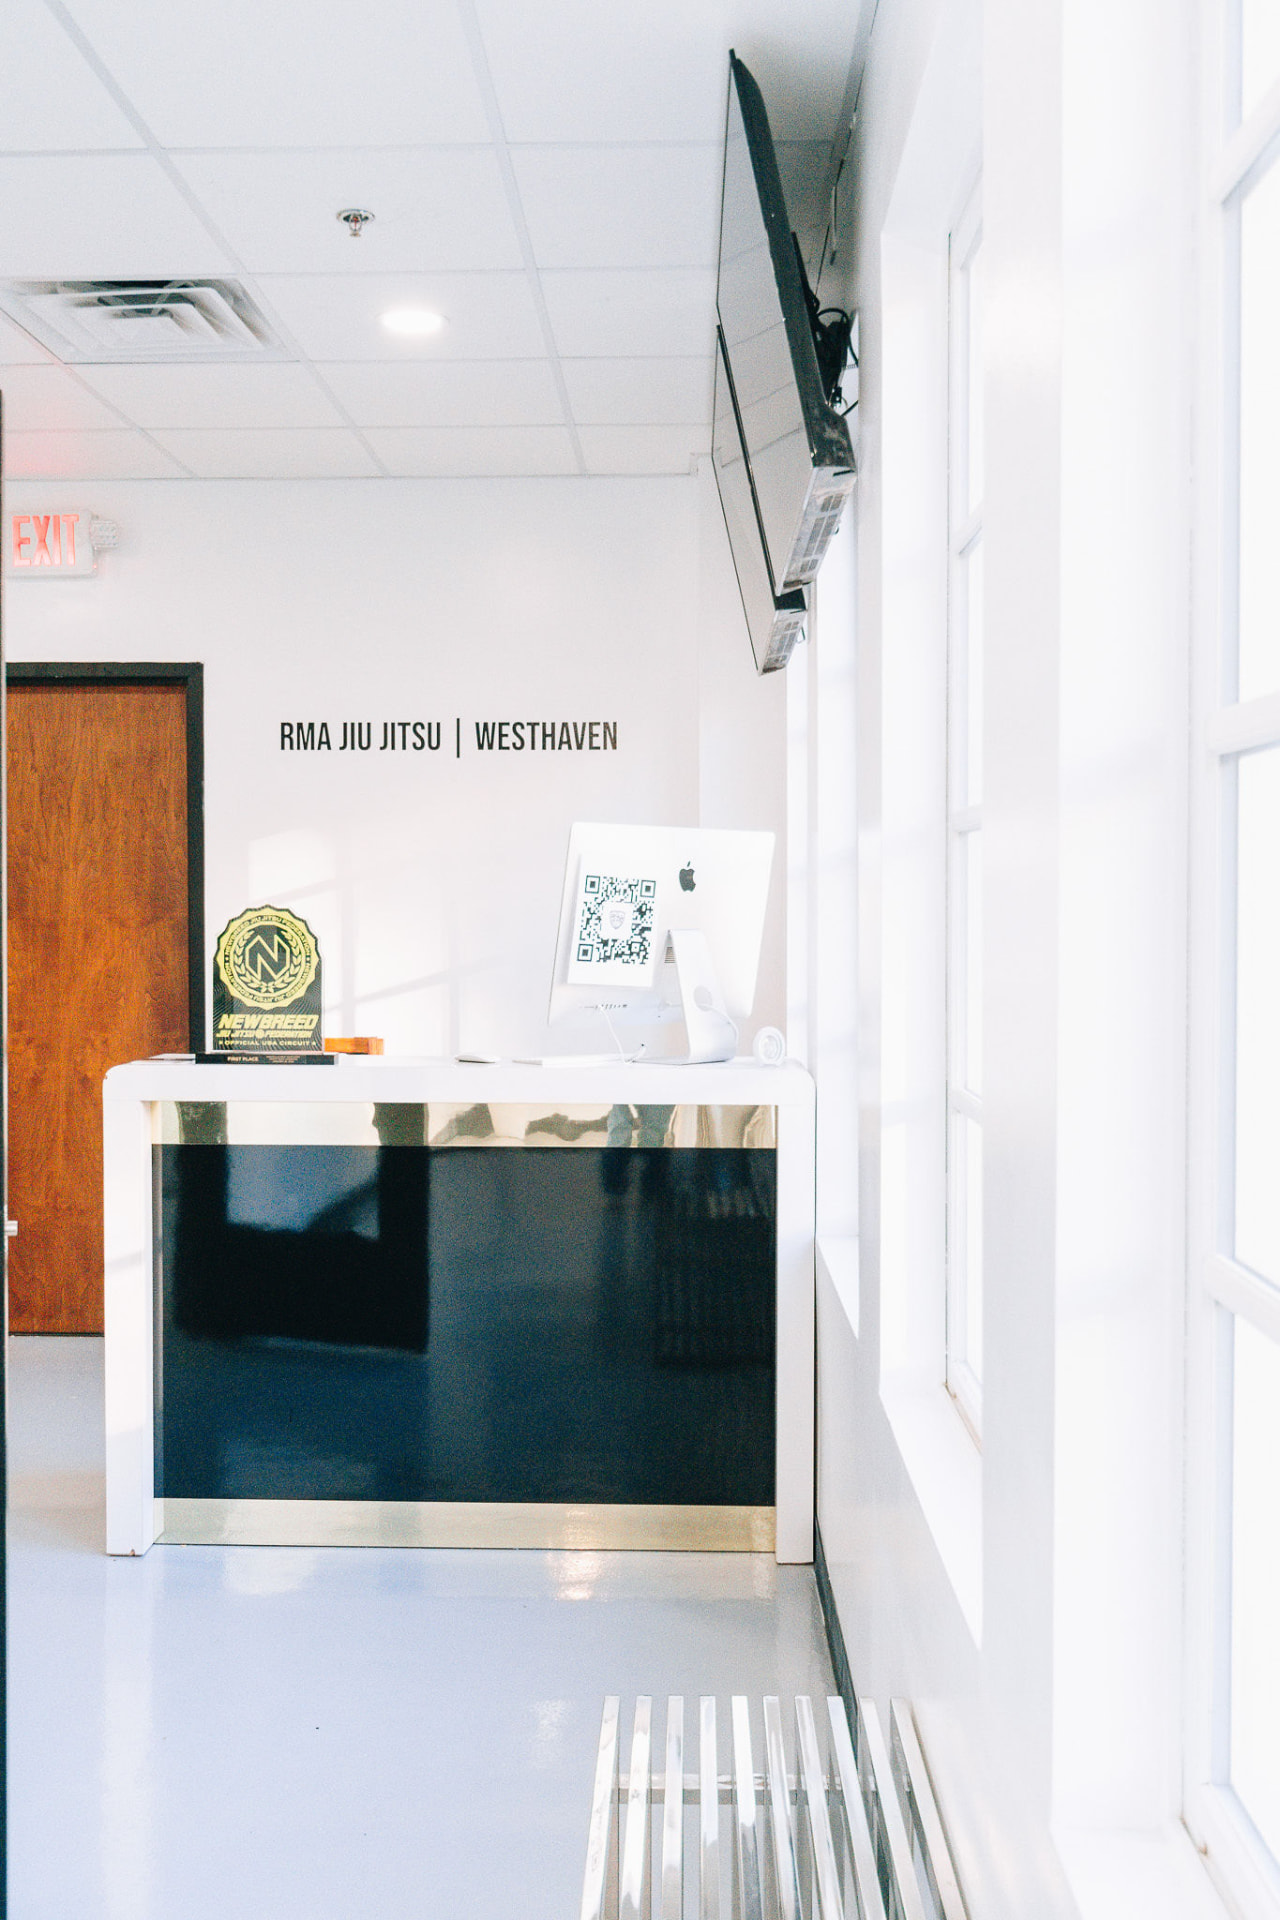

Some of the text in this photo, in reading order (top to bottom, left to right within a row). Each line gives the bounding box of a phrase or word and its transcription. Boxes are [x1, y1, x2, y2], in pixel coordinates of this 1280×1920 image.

[12, 514, 79, 567] EXIT
[280, 721, 332, 751] RMA
[339, 721, 372, 751] JIU
[380, 721, 441, 751] JITSU
[475, 721, 618, 751] WESTHAVEN
[218, 1014, 319, 1029] NEWBREED
